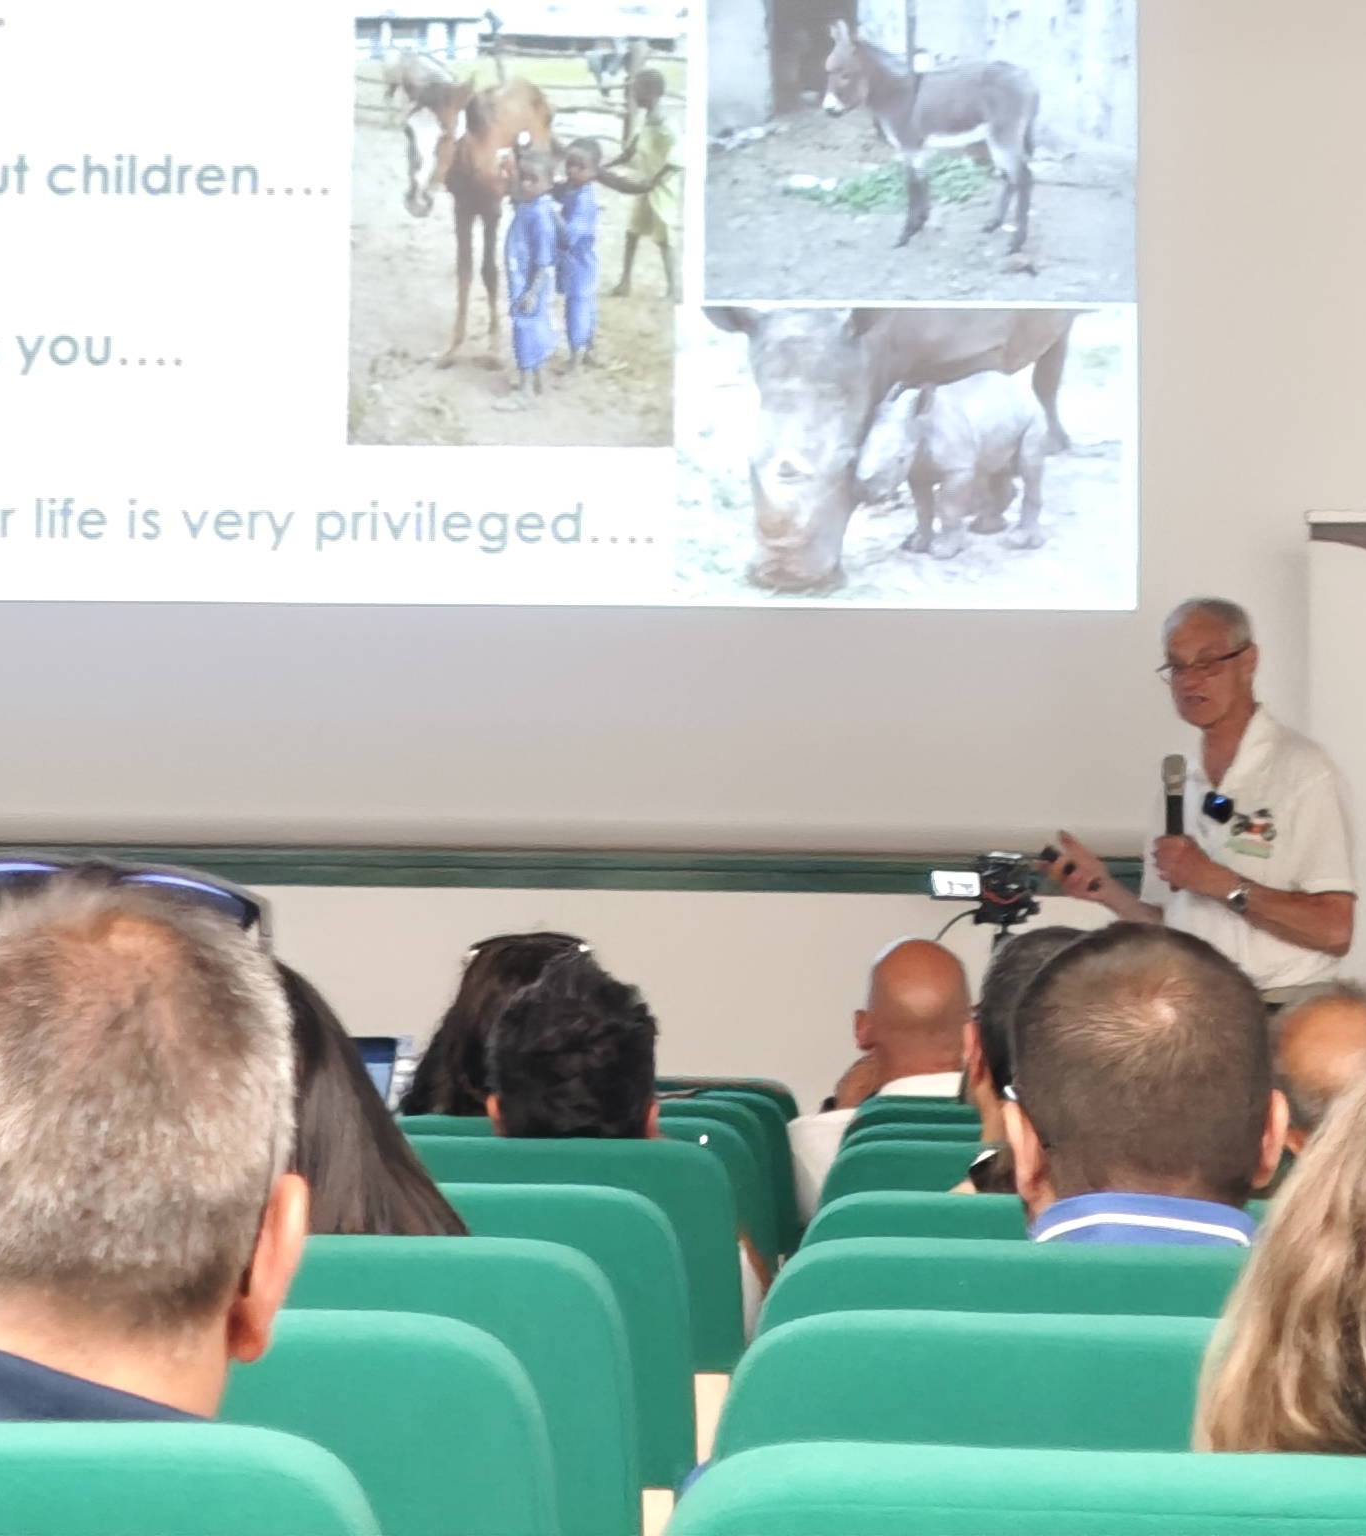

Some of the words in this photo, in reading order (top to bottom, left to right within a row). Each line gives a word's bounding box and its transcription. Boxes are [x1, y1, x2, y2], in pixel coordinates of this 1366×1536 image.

[35, 498, 107, 540] life
[129, 498, 161, 540] is
[182, 509, 294, 551] very
